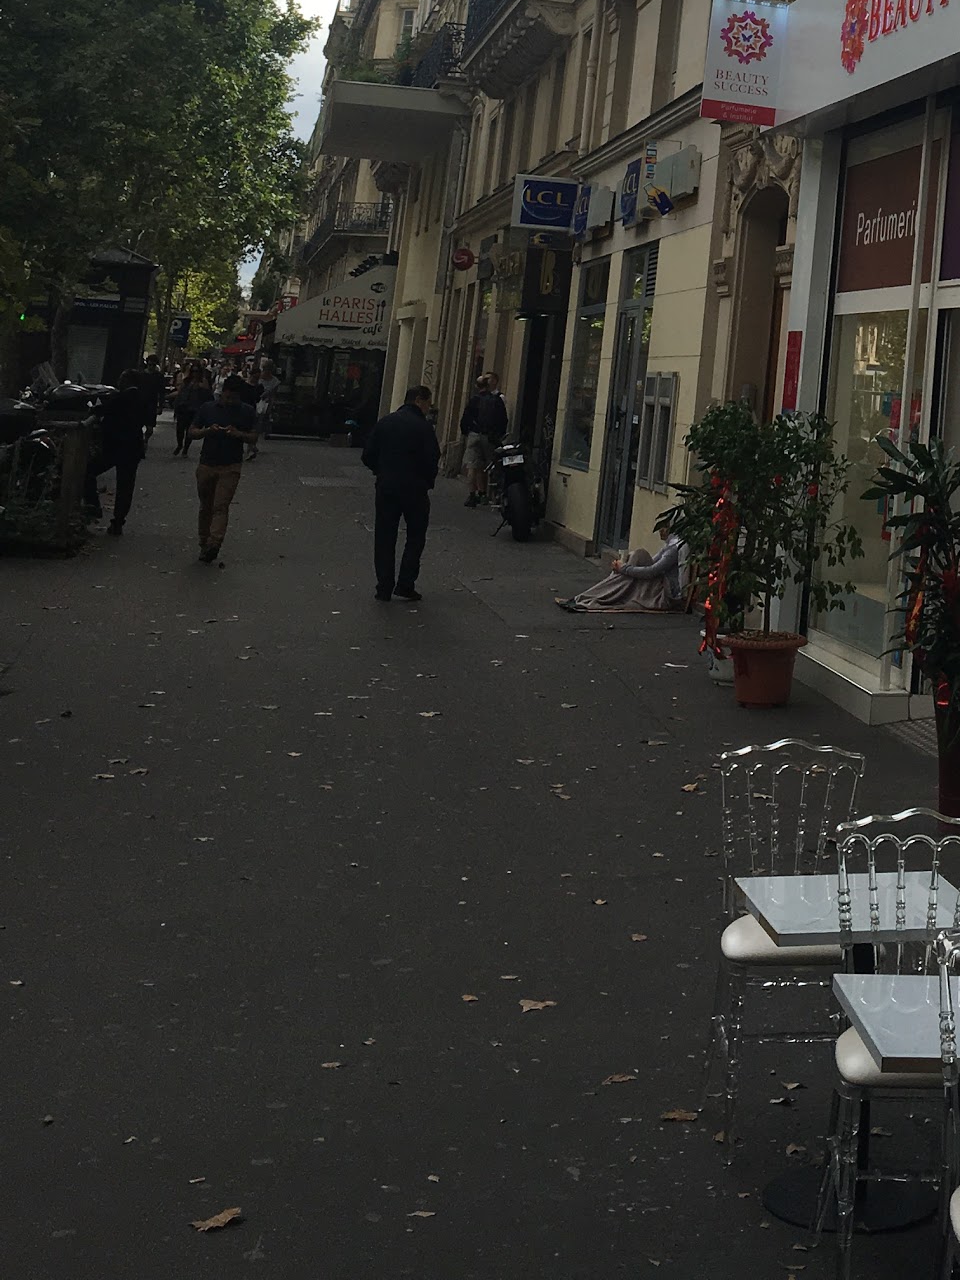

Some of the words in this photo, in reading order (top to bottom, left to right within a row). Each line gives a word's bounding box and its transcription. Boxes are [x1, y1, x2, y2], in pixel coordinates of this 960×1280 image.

[715, 69, 769, 86] BEAUTY
[713, 81, 769, 96] SUCCESS
[721, 103, 757, 114] Parfumerie
[729, 112, 754, 121] Institut
[623, 172, 637, 195] LCL
[525, 189, 569, 207] LCL
[855, 200, 918, 246] Parfumeri
[333, 296, 375, 311] PARIS
[319, 309, 374, 324] HALLES
[362, 323, 382, 335] café
